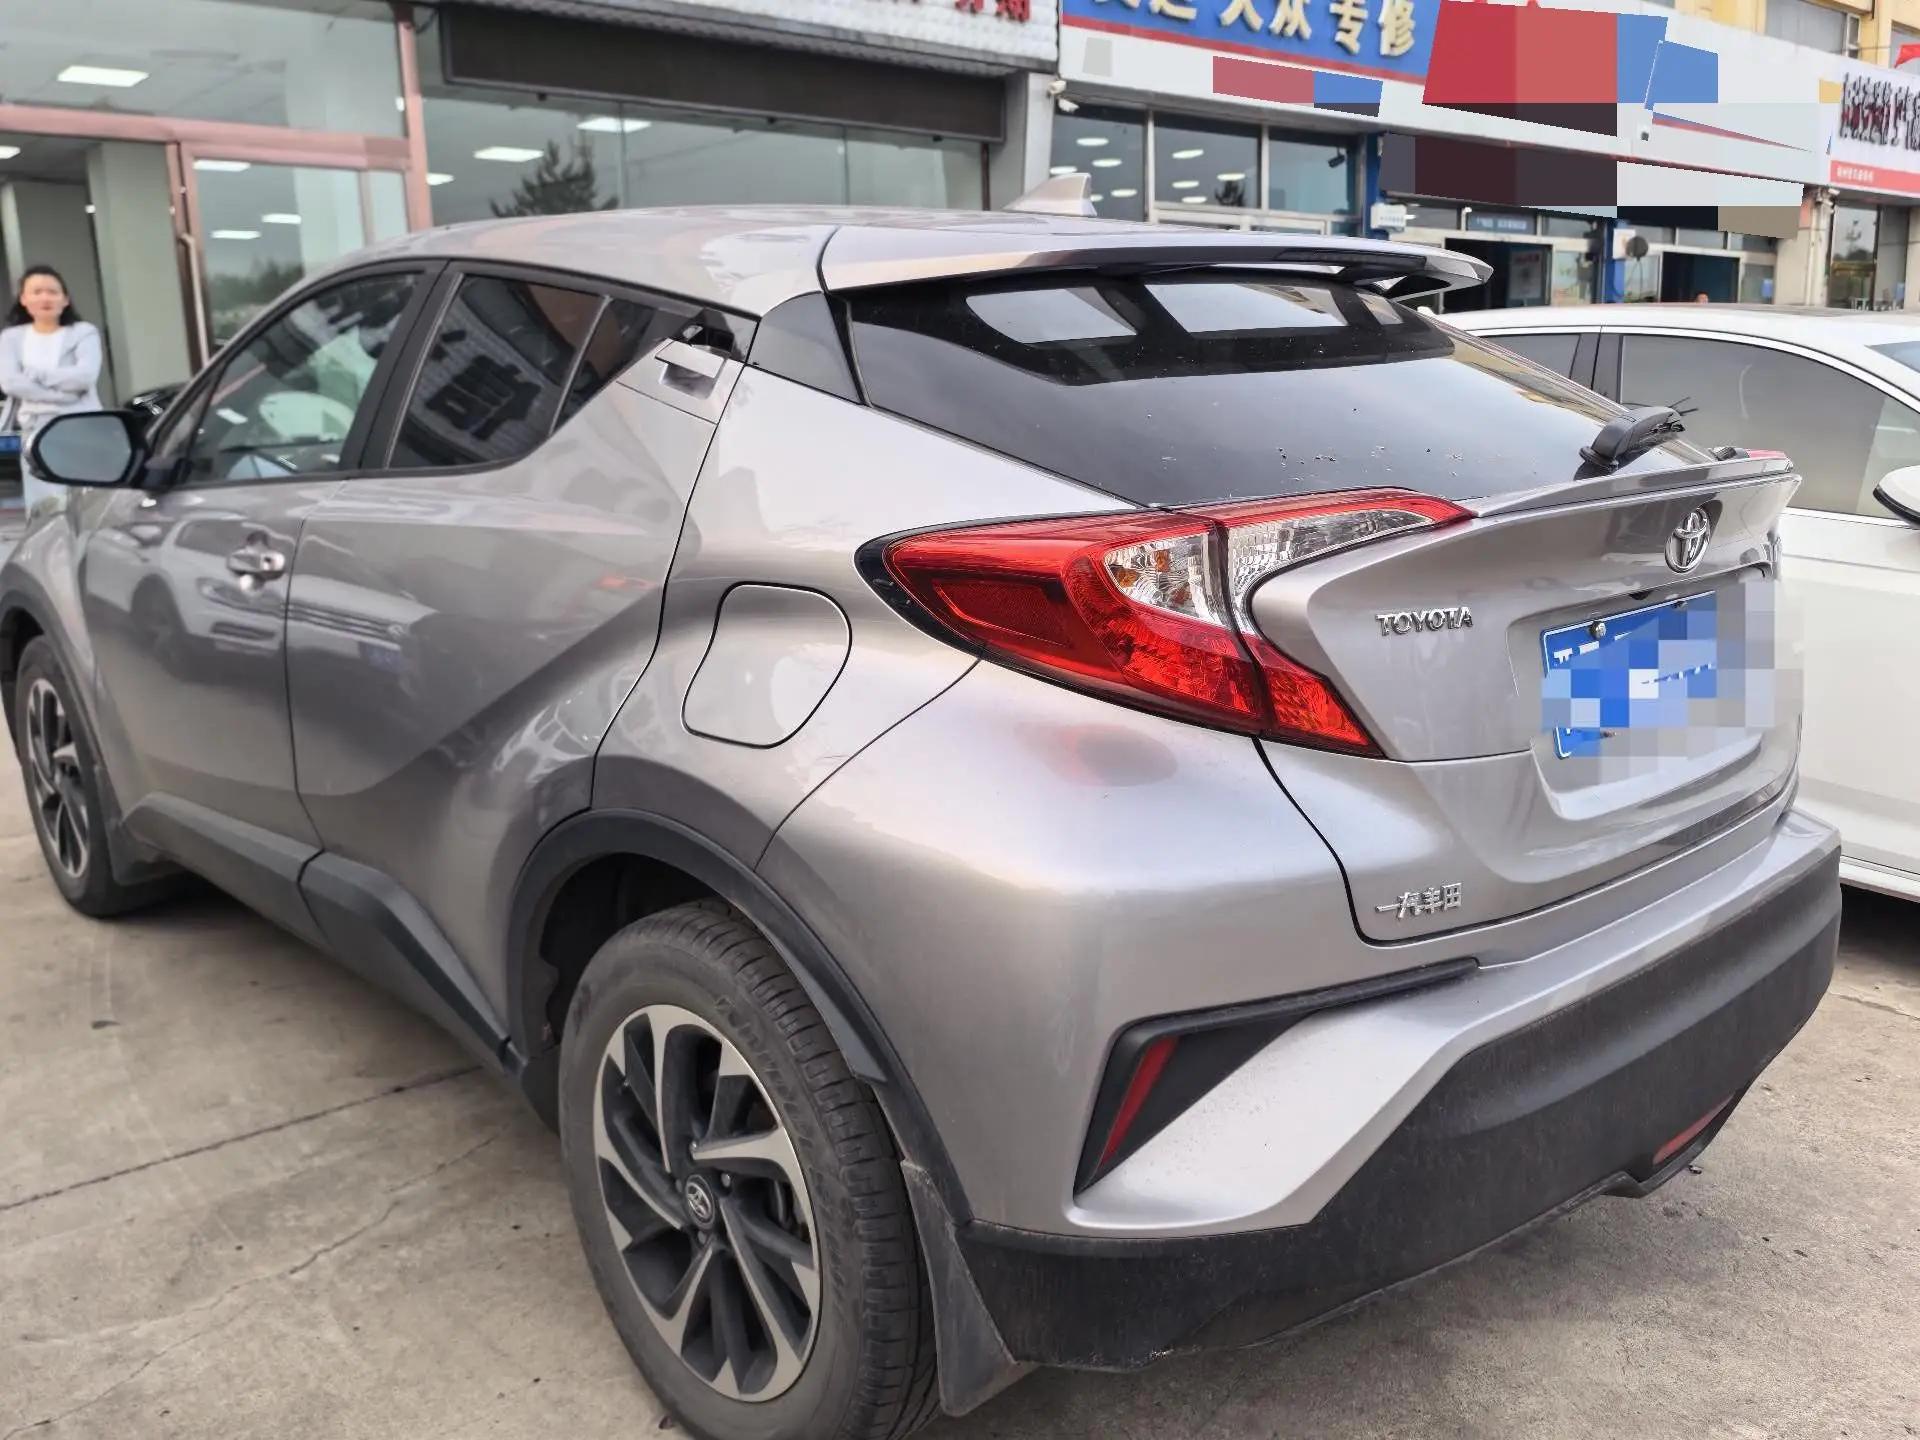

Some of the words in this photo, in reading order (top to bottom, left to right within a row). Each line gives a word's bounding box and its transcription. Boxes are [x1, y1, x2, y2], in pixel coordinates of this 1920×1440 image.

[1375, 606, 1473, 637] TOYOTA
[1375, 882, 1462, 921] 一汽丰田
